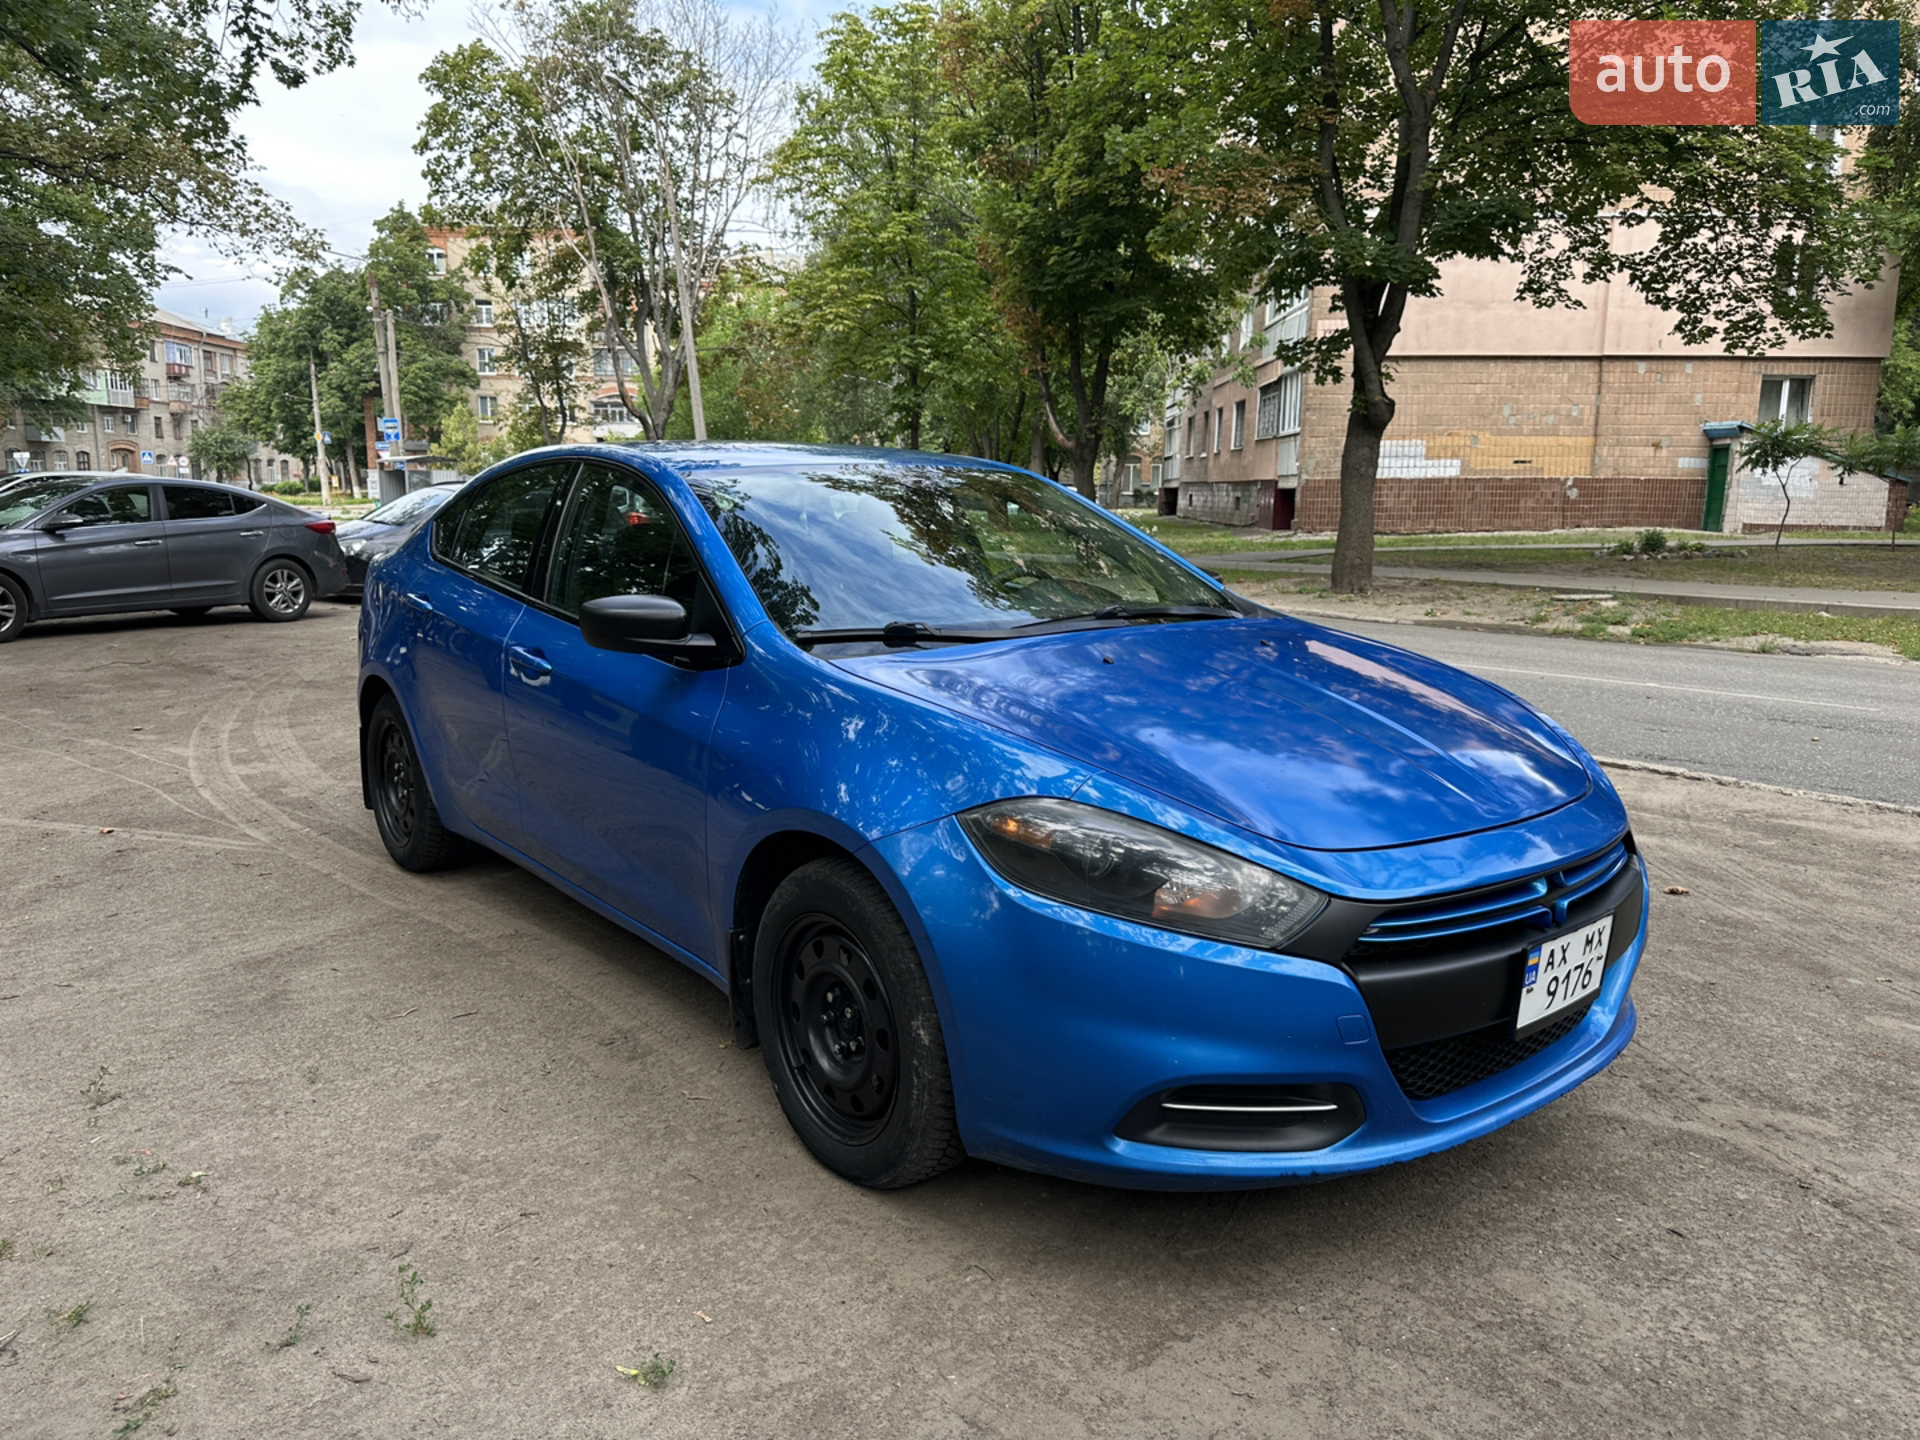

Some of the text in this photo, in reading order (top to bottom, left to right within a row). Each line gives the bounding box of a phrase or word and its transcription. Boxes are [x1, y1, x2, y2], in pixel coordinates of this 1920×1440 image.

[1543, 925, 1606, 974] AX MX
[1524, 970, 1537, 985] UA
[1544, 956, 1594, 1010] 9176
